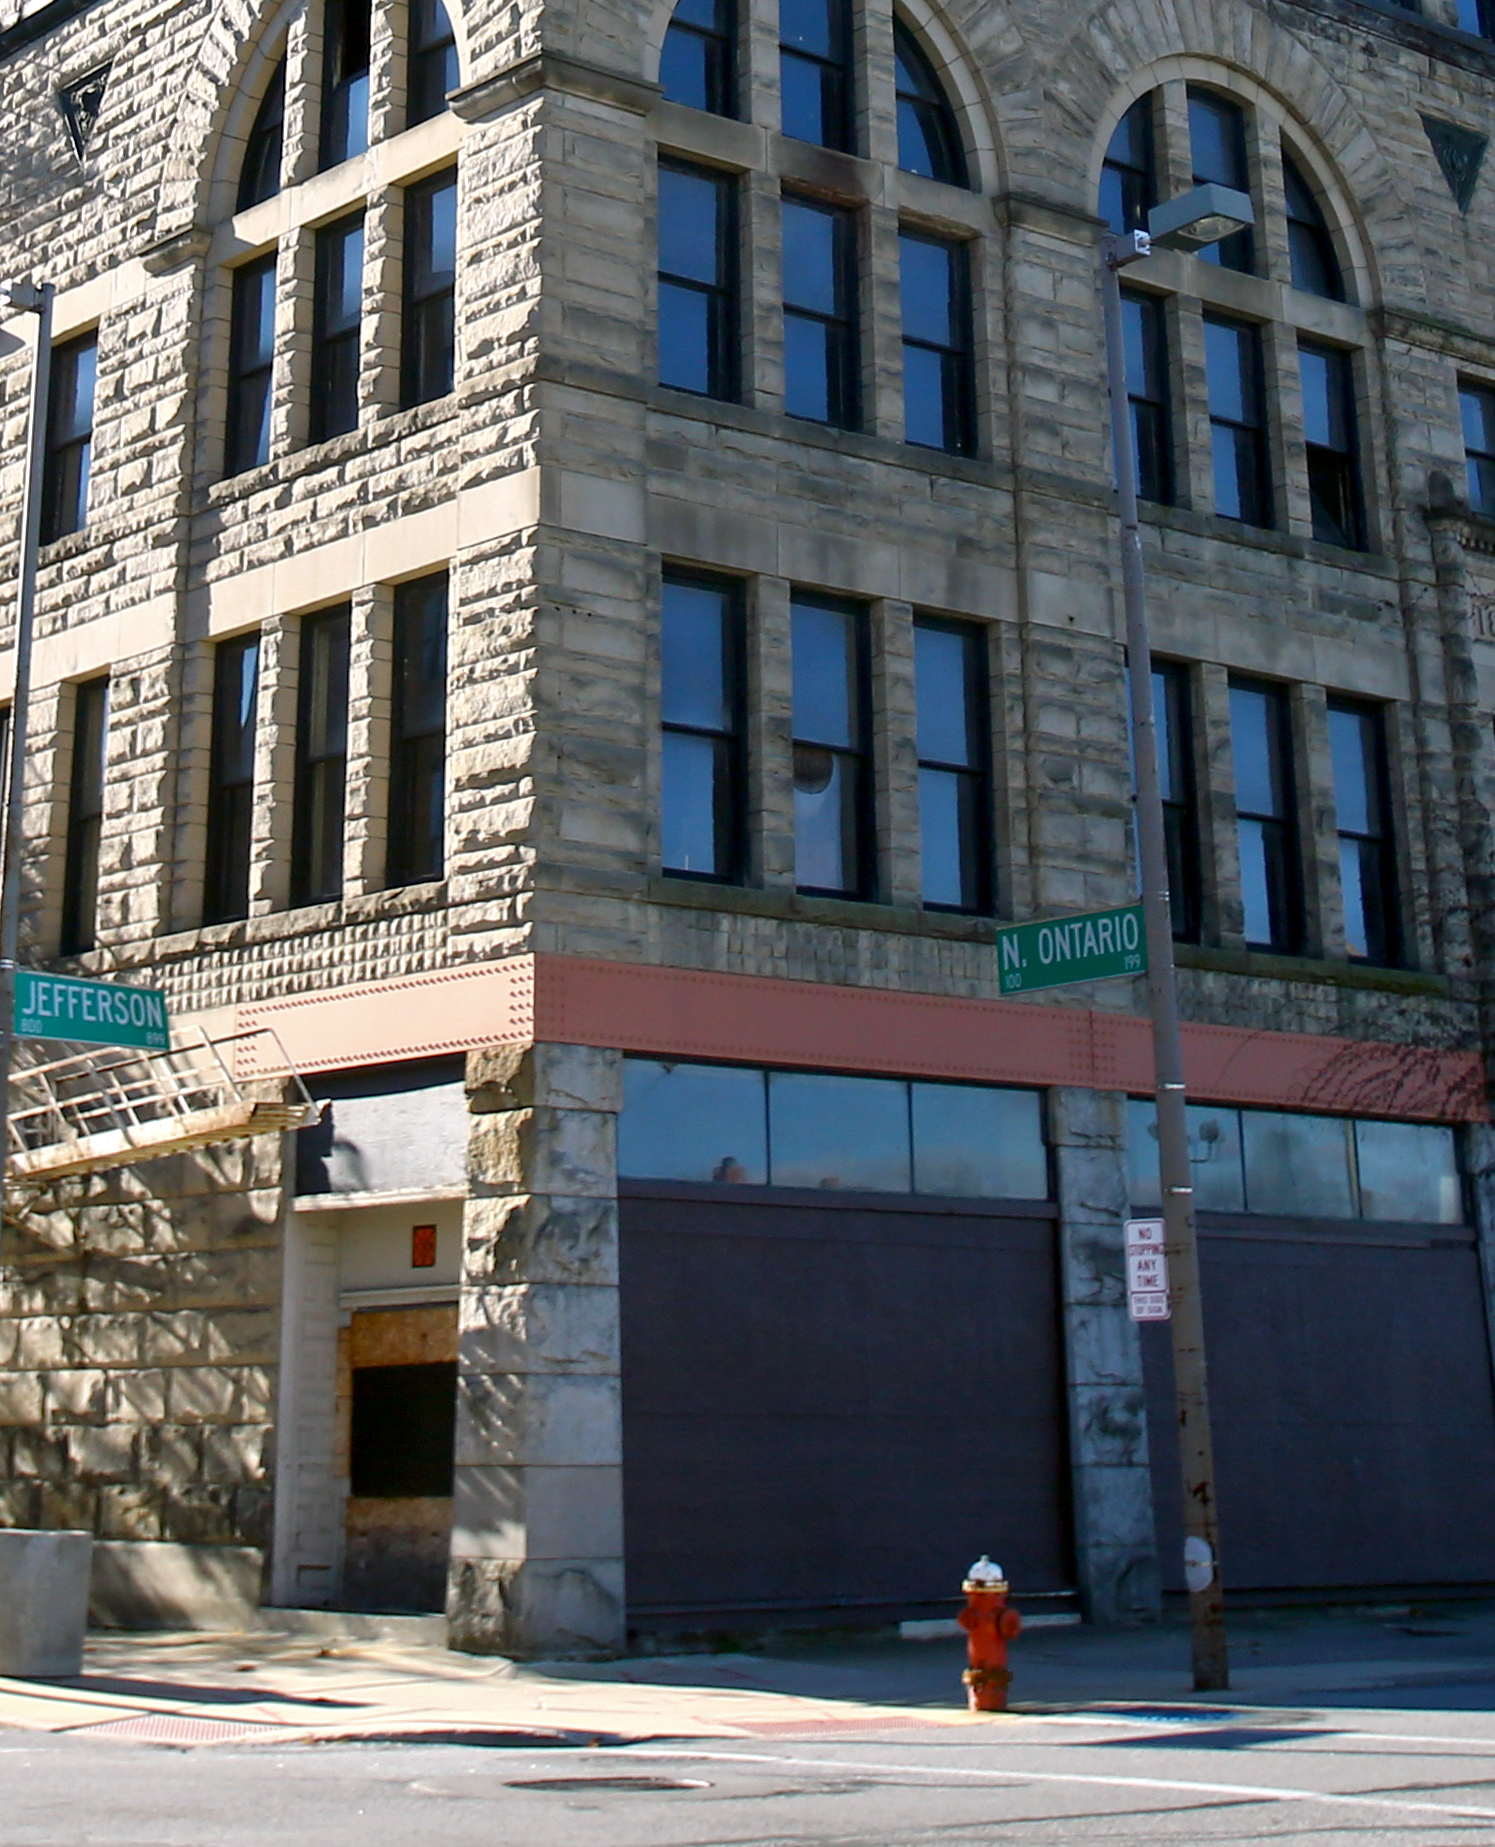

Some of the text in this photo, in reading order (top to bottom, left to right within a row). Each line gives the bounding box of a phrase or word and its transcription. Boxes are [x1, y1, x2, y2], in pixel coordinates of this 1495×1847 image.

[1003, 913, 1139, 970] N. ONTARIO
[1124, 954, 1141, 970] 199
[1005, 974, 1021, 989] 100
[22, 980, 163, 1028] JEFFERSON
[146, 1032, 165, 1046] 899
[1138, 1227, 1152, 1240] NO
[1137, 1259, 1156, 1271] ANY
[1137, 1274, 1159, 1288] TIME
